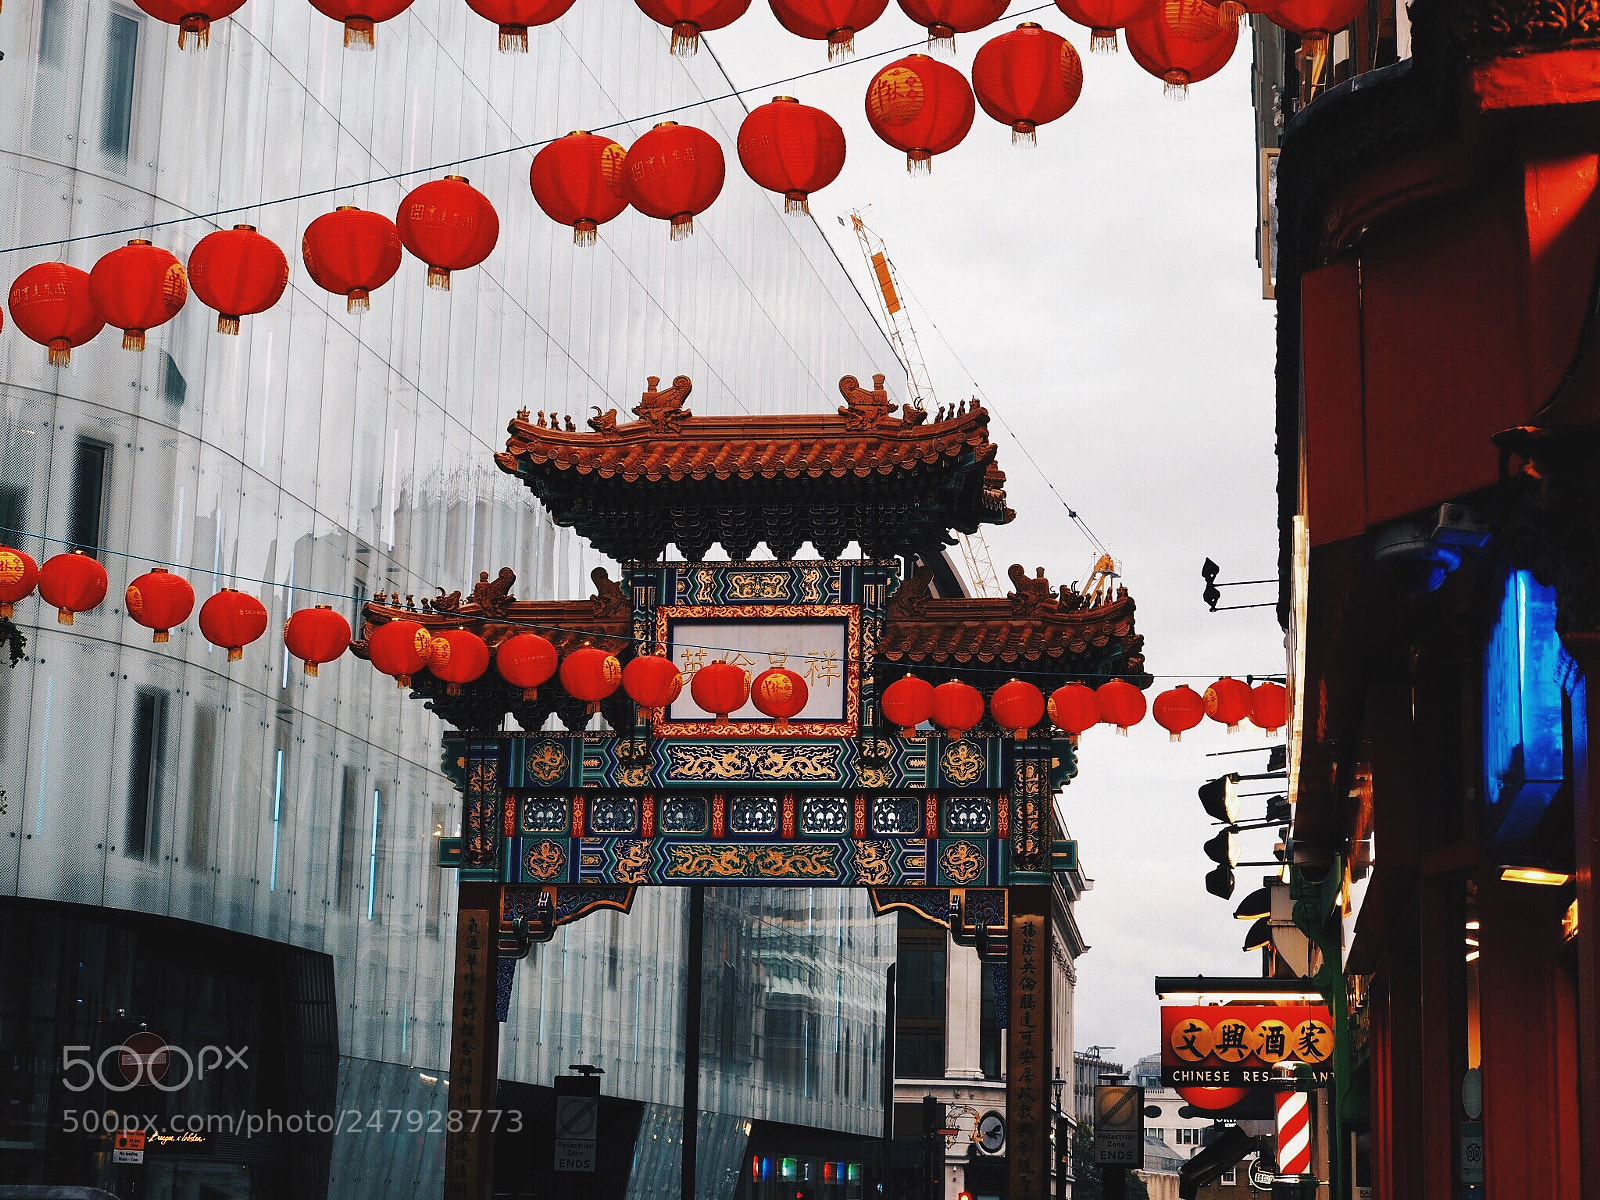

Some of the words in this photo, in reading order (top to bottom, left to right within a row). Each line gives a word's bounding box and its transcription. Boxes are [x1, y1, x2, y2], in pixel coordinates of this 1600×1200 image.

[1175, 1020, 1327, 1059] 文興酒家
[1172, 1070, 1230, 1082] CHINESE
[557, 1141, 594, 1150] Pedestrian
[1100, 1150, 1133, 1160] ENDS
[559, 1159, 591, 1169] ENDS
